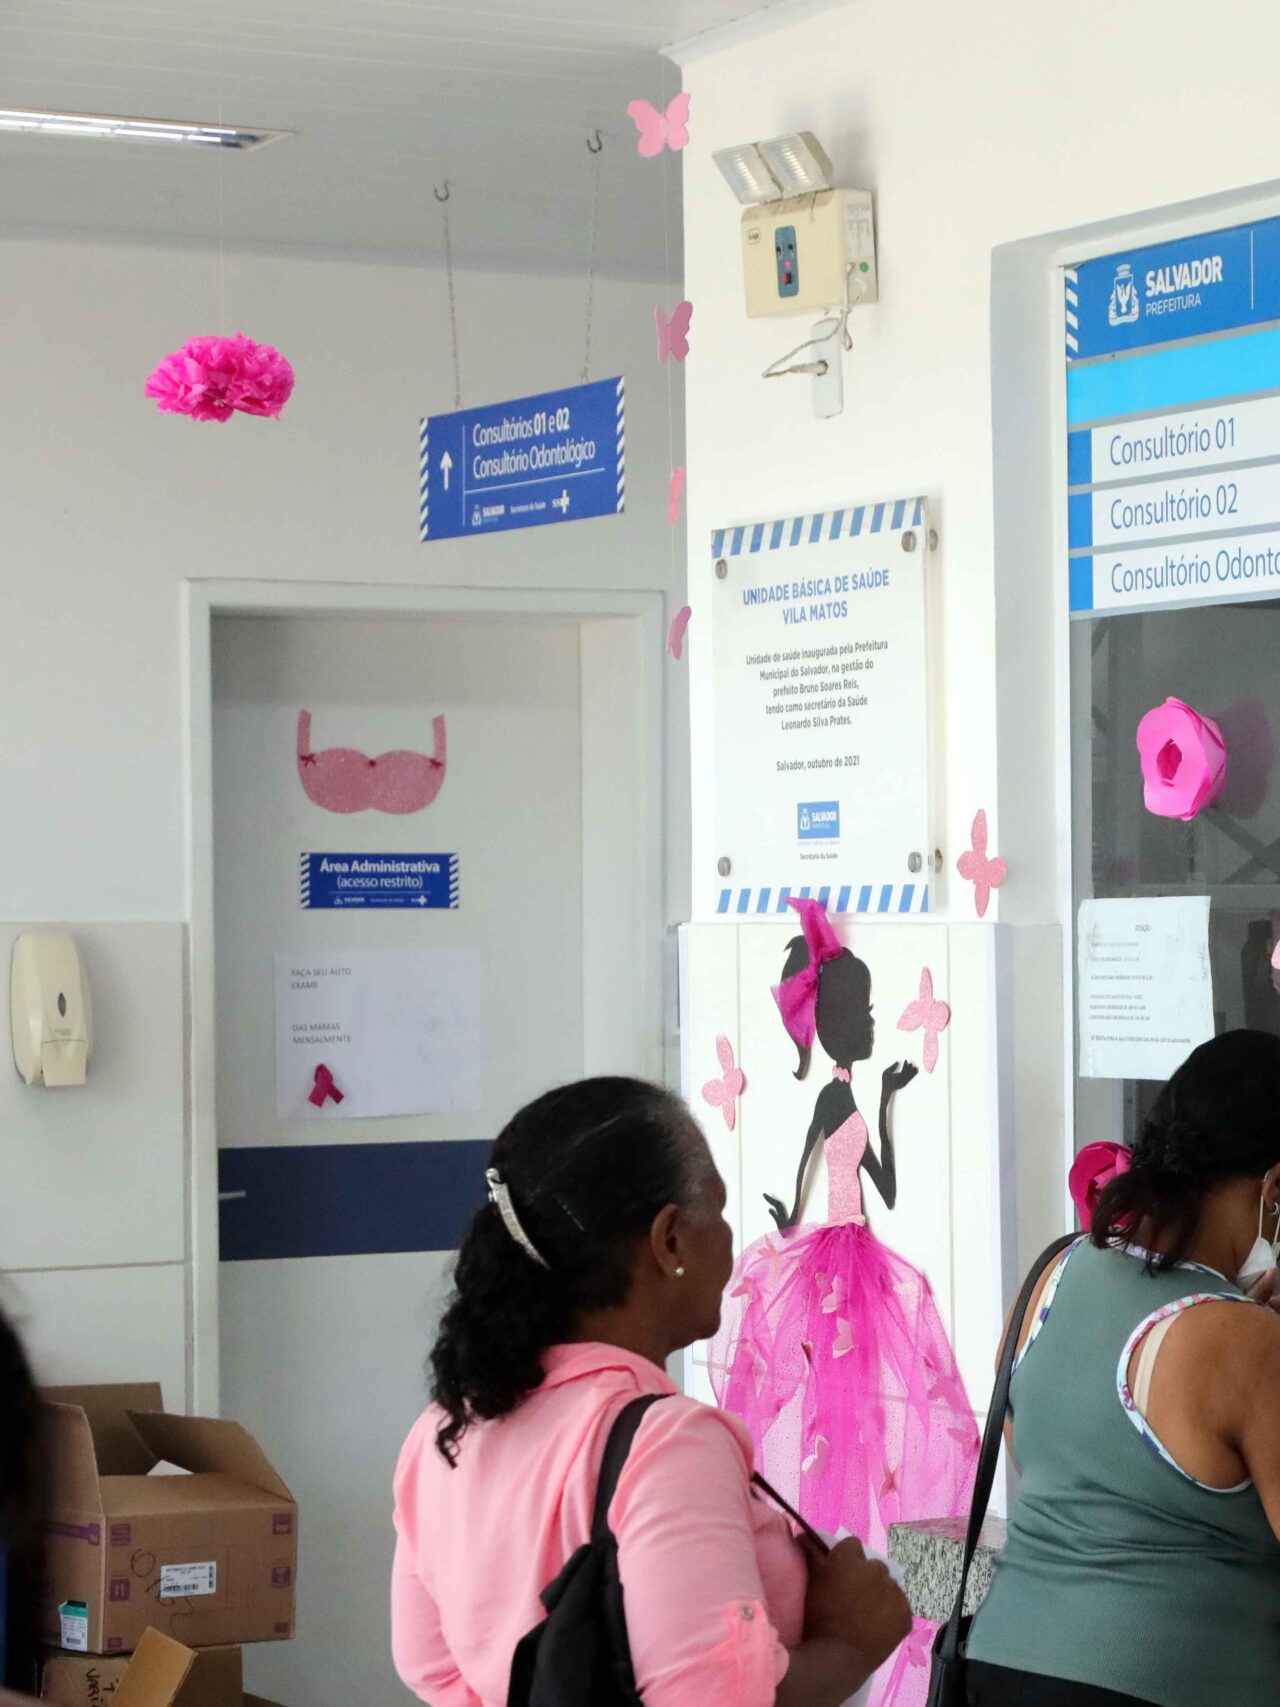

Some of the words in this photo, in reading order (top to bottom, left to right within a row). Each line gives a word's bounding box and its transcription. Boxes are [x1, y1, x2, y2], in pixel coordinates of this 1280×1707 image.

[1145, 255, 1223, 298] SALVADOR
[1145, 294, 1202, 316] PREFEITURA
[472, 416, 533, 447] Consultórios
[534, 411, 547, 437] 01
[548, 416, 556, 433] e
[556, 406, 570, 432] 02
[1110, 422, 1211, 466] Consultório
[1215, 417, 1236, 449] 01
[473, 448, 529, 480] Consultório
[529, 437, 596, 470] Odontológico
[1110, 488, 1211, 530] Consultório
[1216, 483, 1238, 516] 02
[1111, 553, 1211, 593] Consultório
[743, 583, 790, 606] UNIDADE
[792, 577, 832, 600] BÁSICA
[835, 575, 849, 593] DE
[852, 567, 890, 590] SAÚDE
[782, 606, 807, 625] VILA
[809, 601, 848, 622] MATOS
[746, 653, 772, 665] Unidade
[773, 651, 781, 662] de
[782, 649, 801, 661] saúde
[802, 645, 838, 663] inaugurada
[839, 644, 854, 659] pela
[855, 640, 888, 653] Prefeitura
[759, 667, 789, 681] Municipal
[790, 666, 799, 678] do
[800, 664, 830, 678] Salvador,
[831, 663, 840, 673] na
[841, 660, 863, 675] gestão
[865, 660, 874, 670] do
[773, 683, 799, 697] prefeito
[799, 682, 819, 694] Bruno
[820, 680, 842, 692] Soares
[765, 703, 784, 715] tendo
[785, 702, 803, 713] como
[804, 697, 836, 712] secretário
[837, 697, 846, 708] da
[847, 694, 868, 707] Saúde
[781, 717, 812, 731] Leonardo
[812, 716, 829, 728] Silva
[776, 759, 806, 772] Salvador,
[807, 758, 833, 769] outubro
[834, 757, 843, 767] de
[844, 755, 860, 767] 2021
[320, 857, 349, 873] Área
[351, 859, 440, 873] Administrativa
[337, 875, 378, 889] (acesso
[380, 875, 424, 889] restrito)
